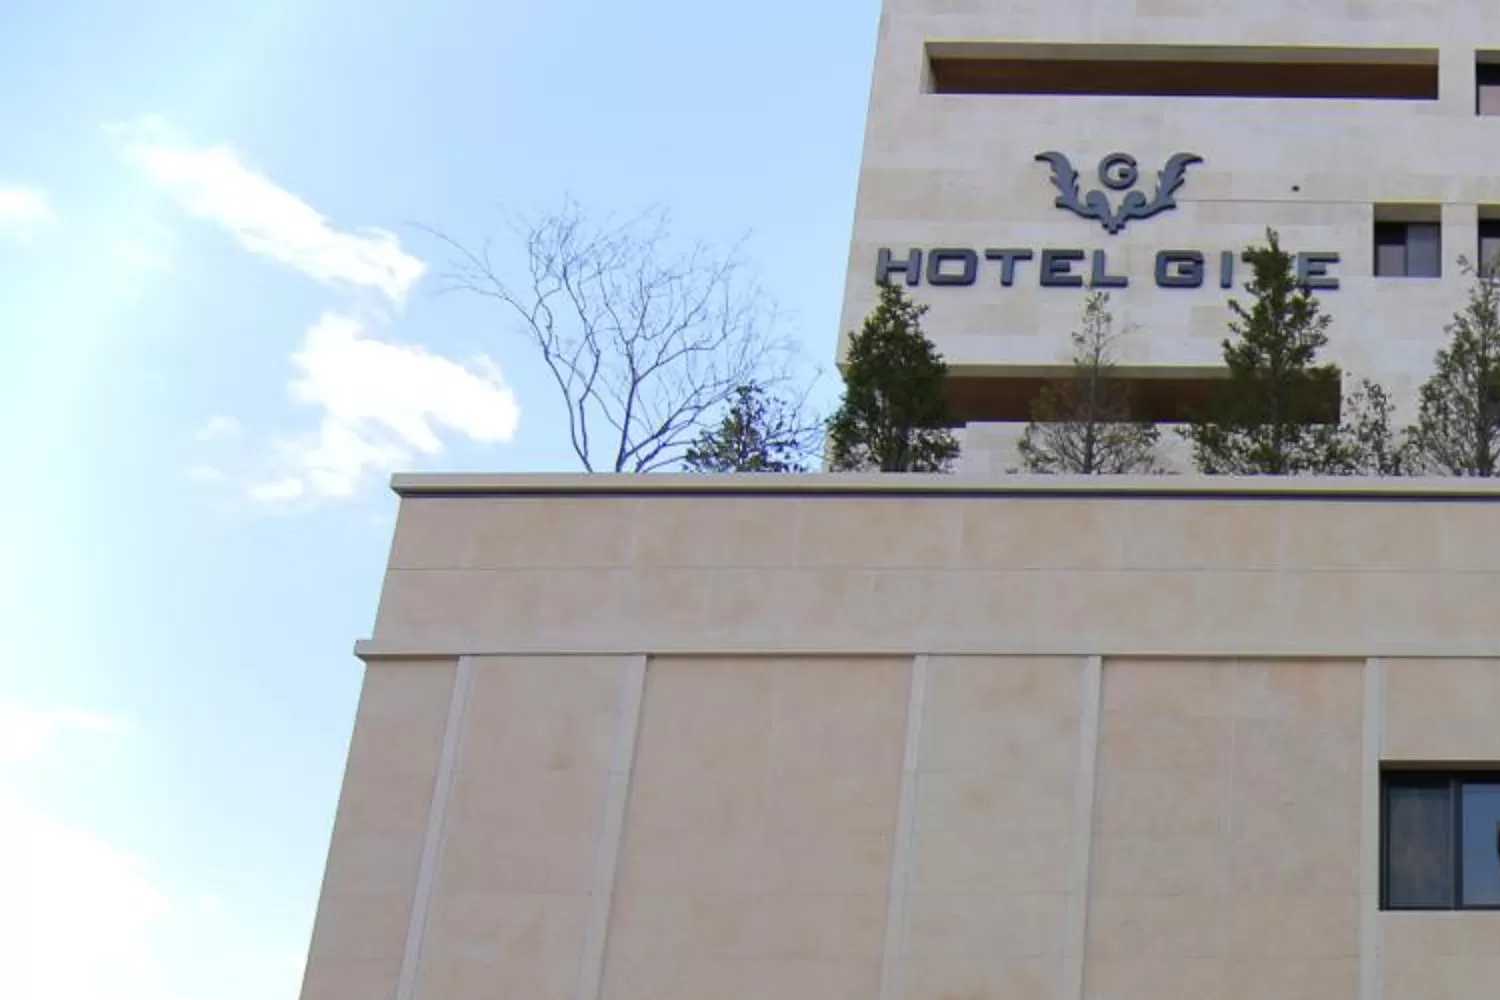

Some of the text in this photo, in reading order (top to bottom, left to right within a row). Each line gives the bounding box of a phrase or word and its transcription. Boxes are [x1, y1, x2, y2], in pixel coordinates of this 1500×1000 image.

[1099, 152, 1139, 190] G
[875, 248, 1340, 290] HOTEL GIE
